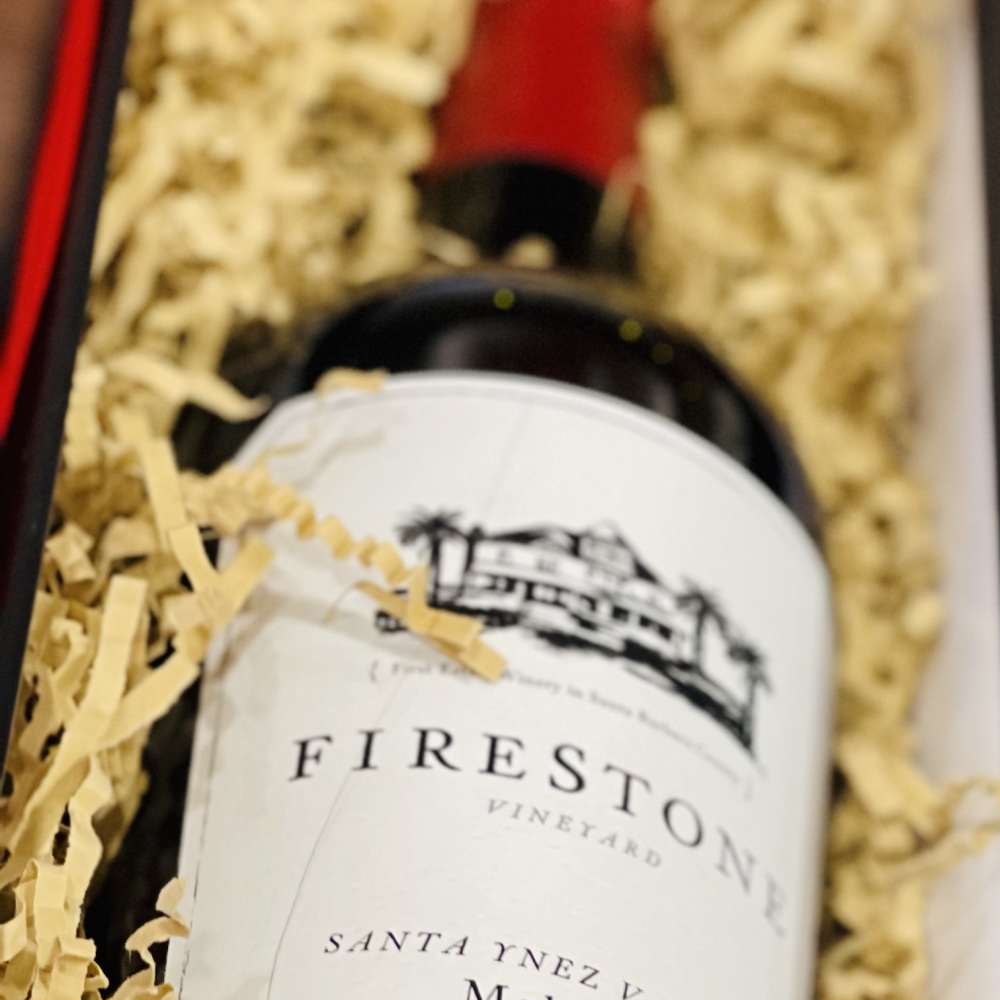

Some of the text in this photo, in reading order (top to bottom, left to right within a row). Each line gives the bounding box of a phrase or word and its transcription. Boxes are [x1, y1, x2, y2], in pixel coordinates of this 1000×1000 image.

[288, 727, 787, 938] FIRESTONE
[485, 798, 663, 869] VINEYARD
[323, 930, 472, 957] SANTA
[494, 941, 602, 990] YNEZ
